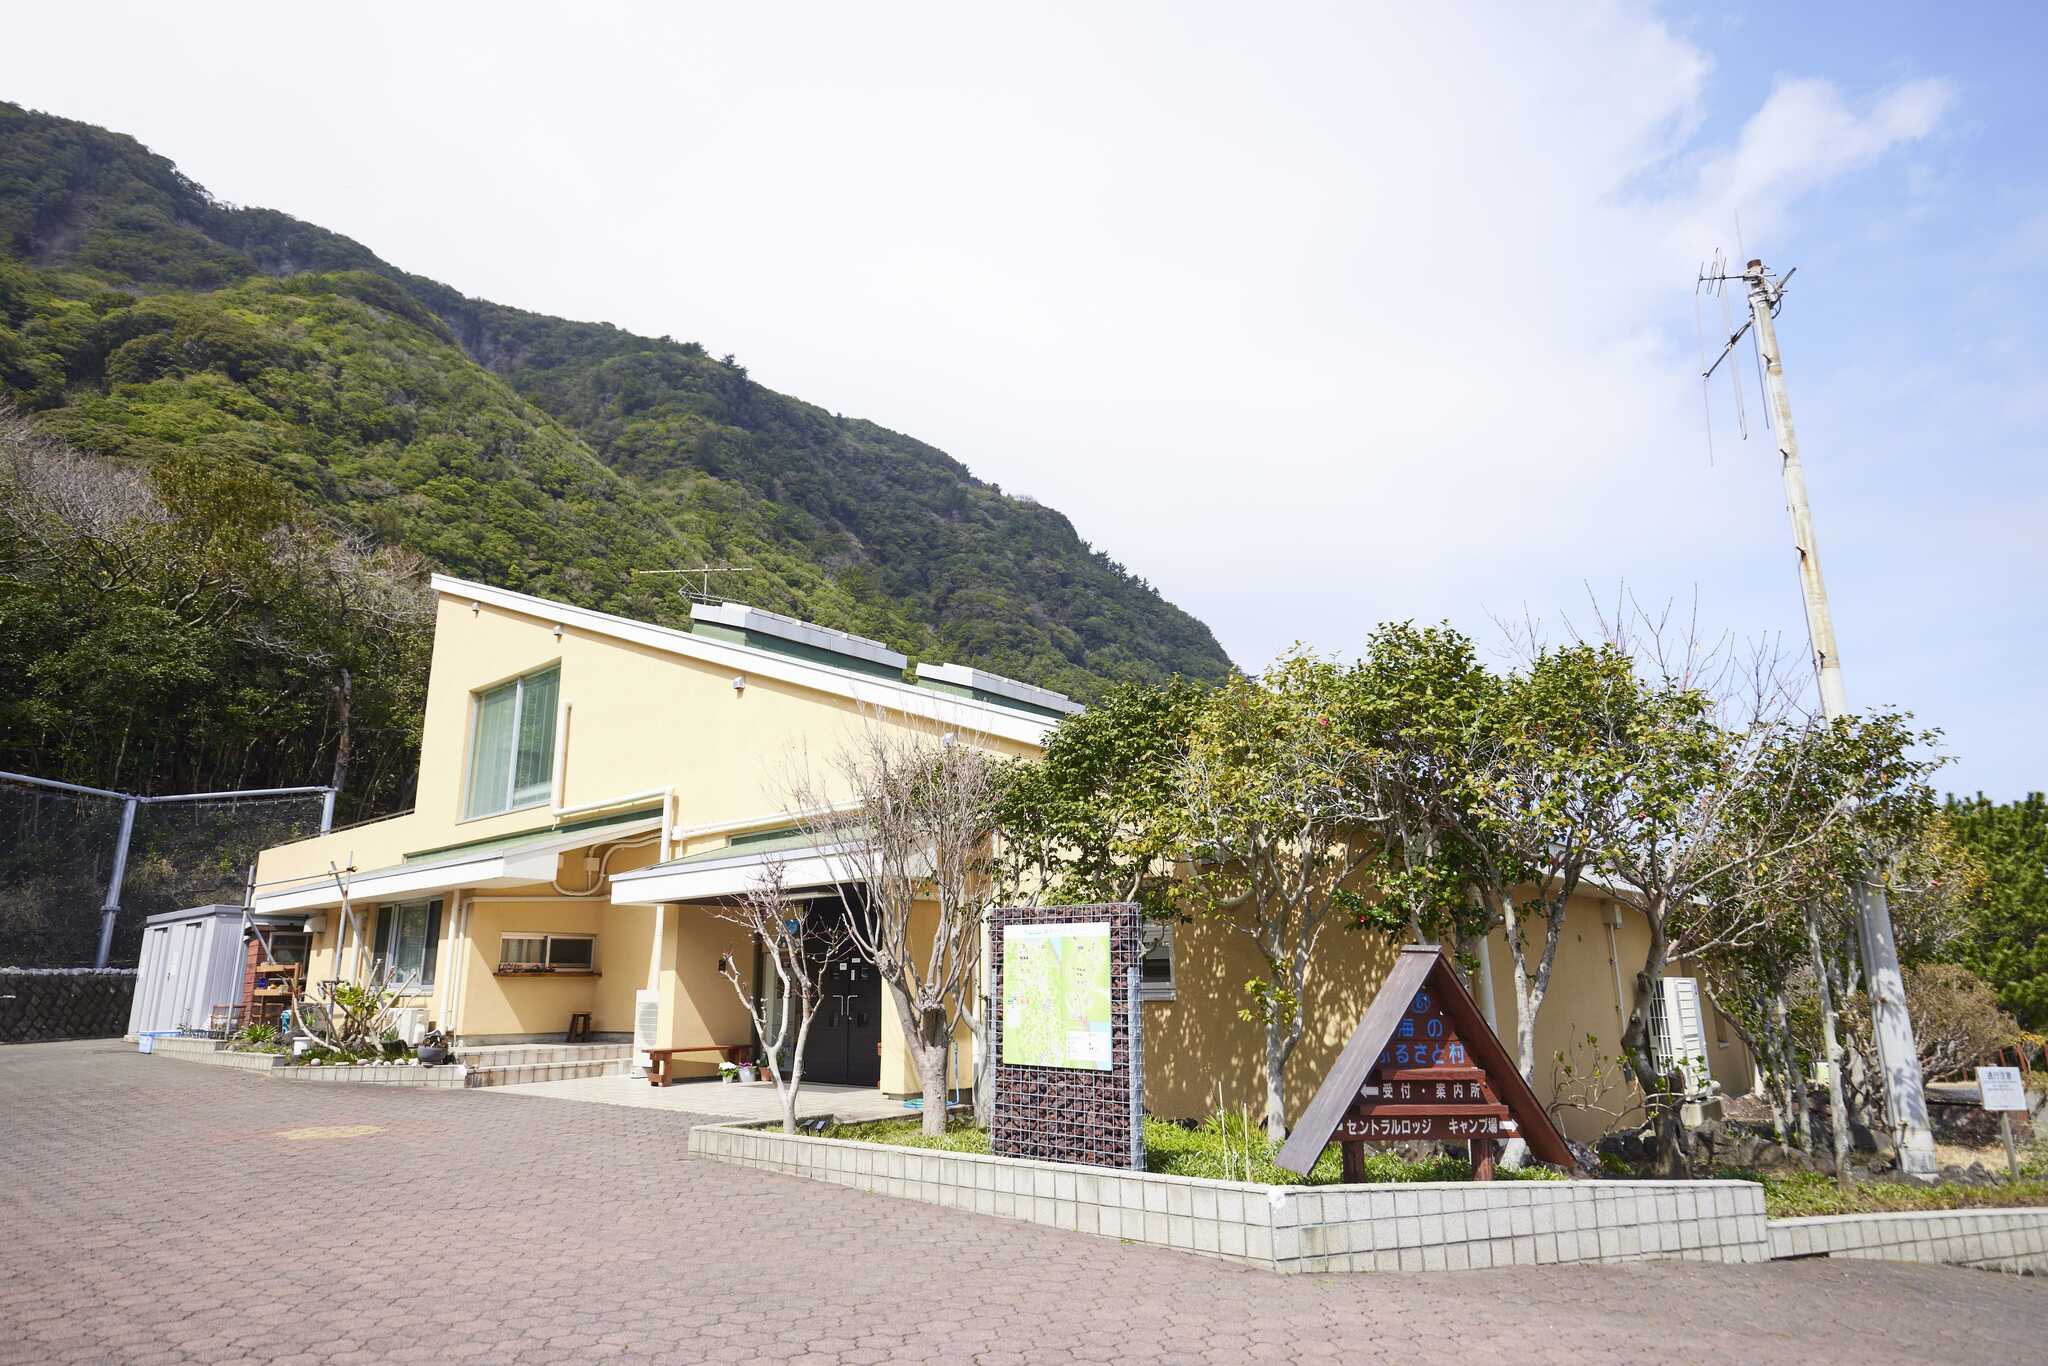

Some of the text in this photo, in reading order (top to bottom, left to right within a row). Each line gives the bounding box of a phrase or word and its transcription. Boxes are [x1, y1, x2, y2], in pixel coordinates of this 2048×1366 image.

[1382, 1082, 1481, 1099] 受付・案内所
[1346, 1117, 1498, 1136] セントラルロッジ キャンプ場
